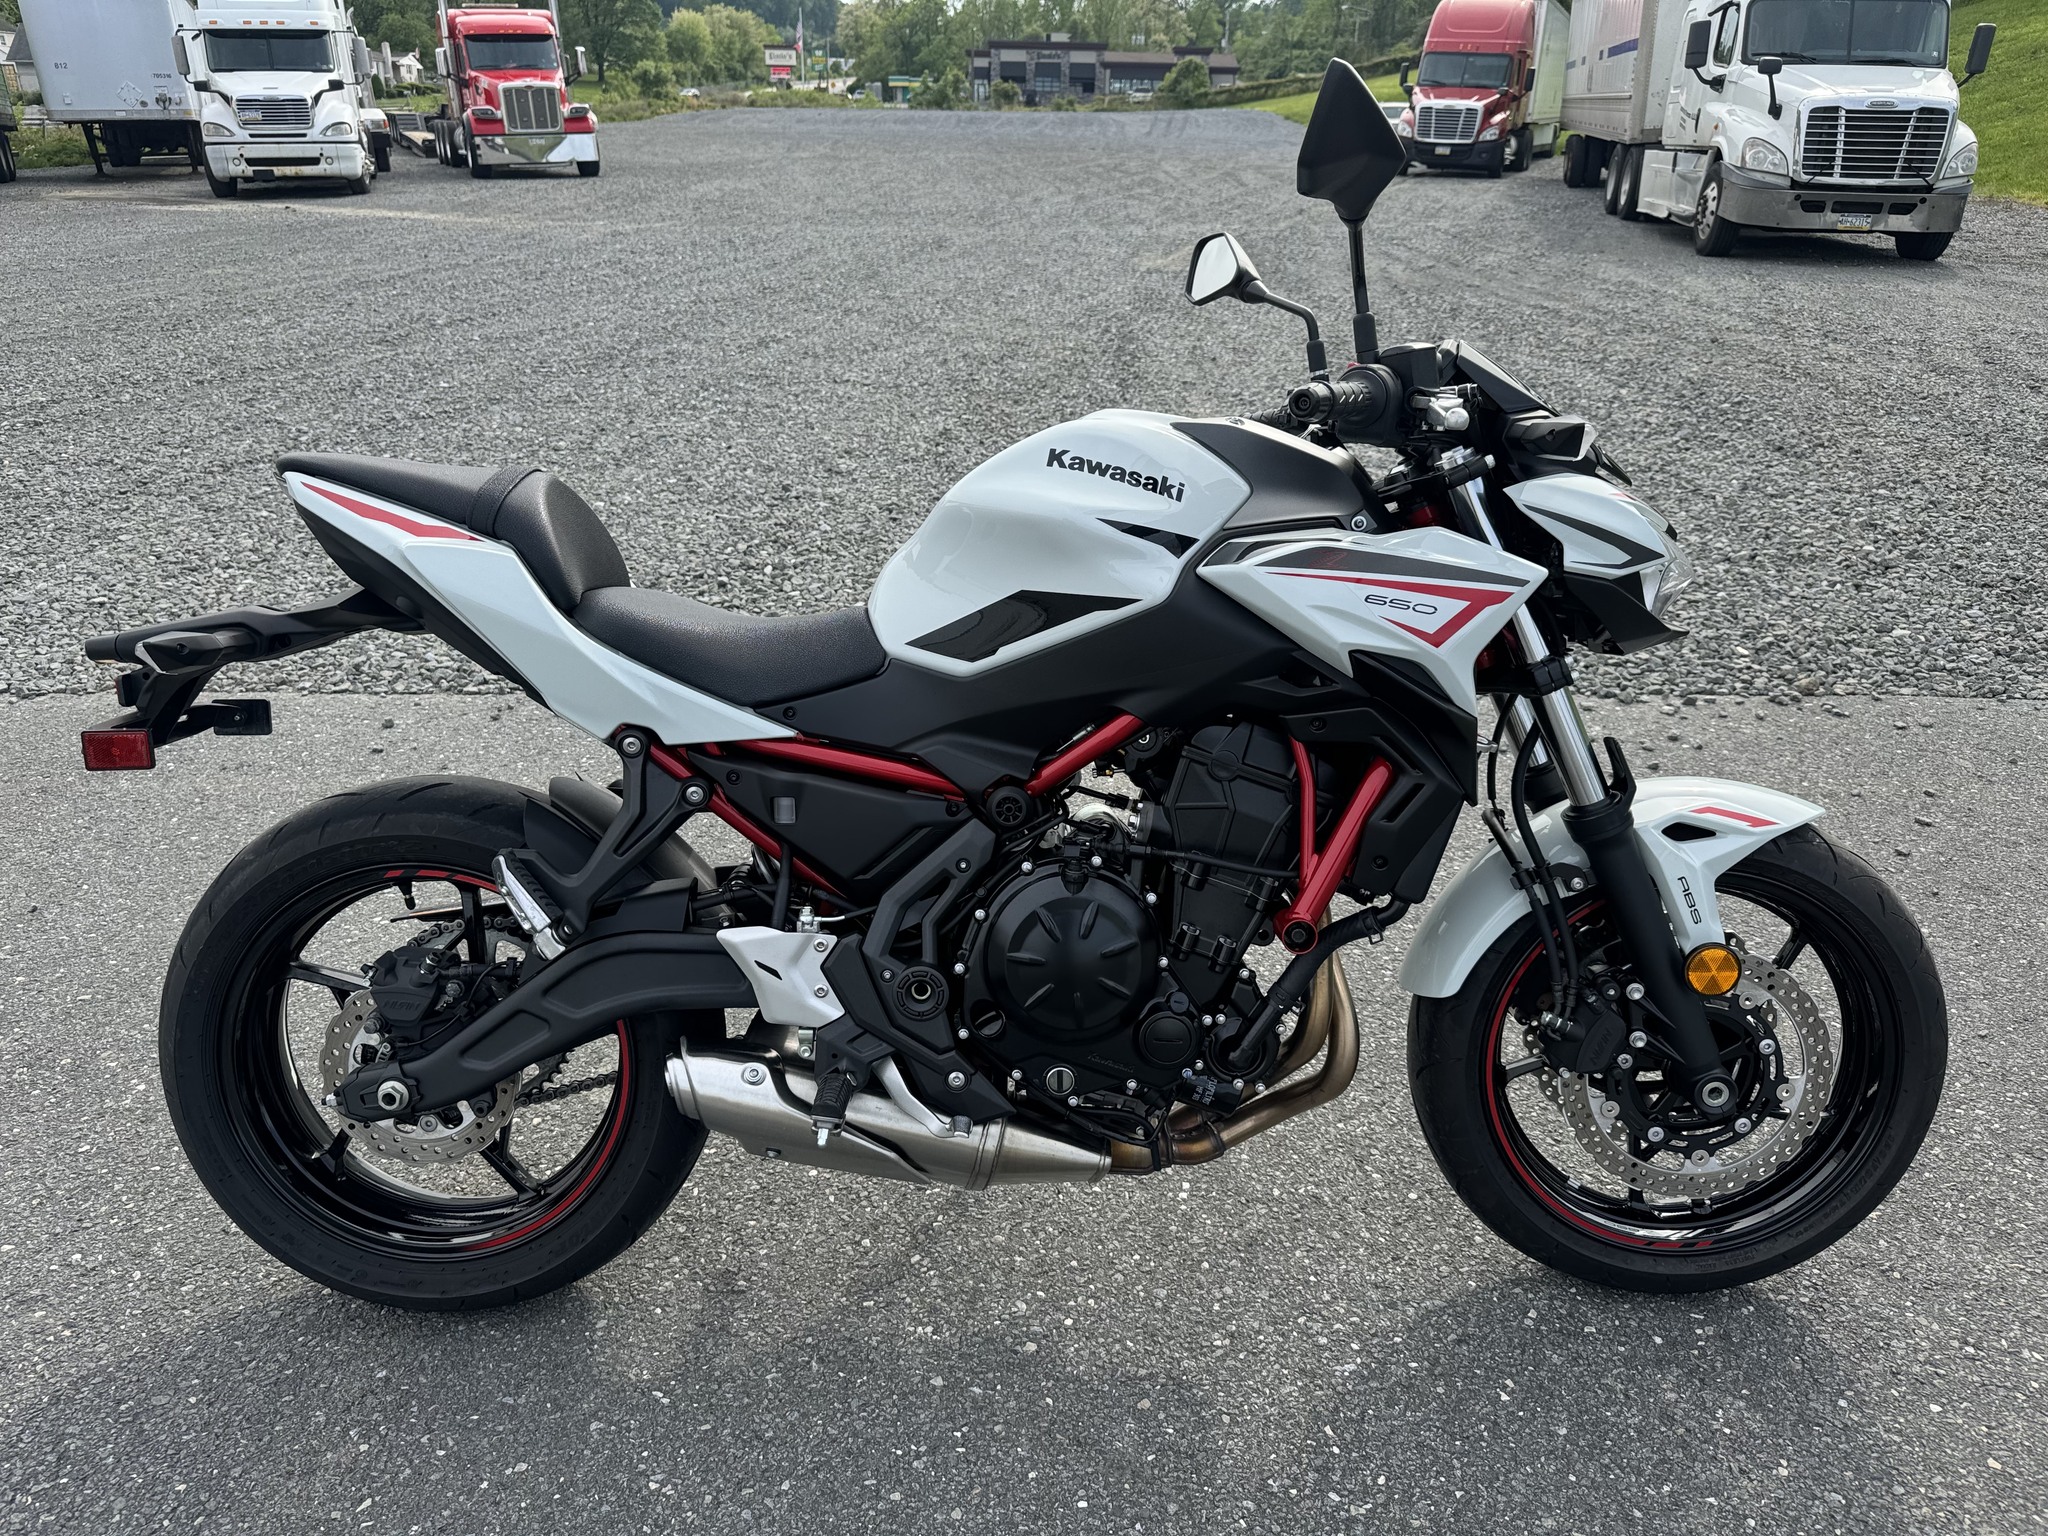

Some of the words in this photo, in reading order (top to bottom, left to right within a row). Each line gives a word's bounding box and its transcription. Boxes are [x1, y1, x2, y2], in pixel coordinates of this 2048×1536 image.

[54, 62, 68, 70] 812
[1046, 448, 1185, 503] Kawasaki
[1364, 594, 1438, 615] 650
[1677, 876, 1702, 925] ABS
